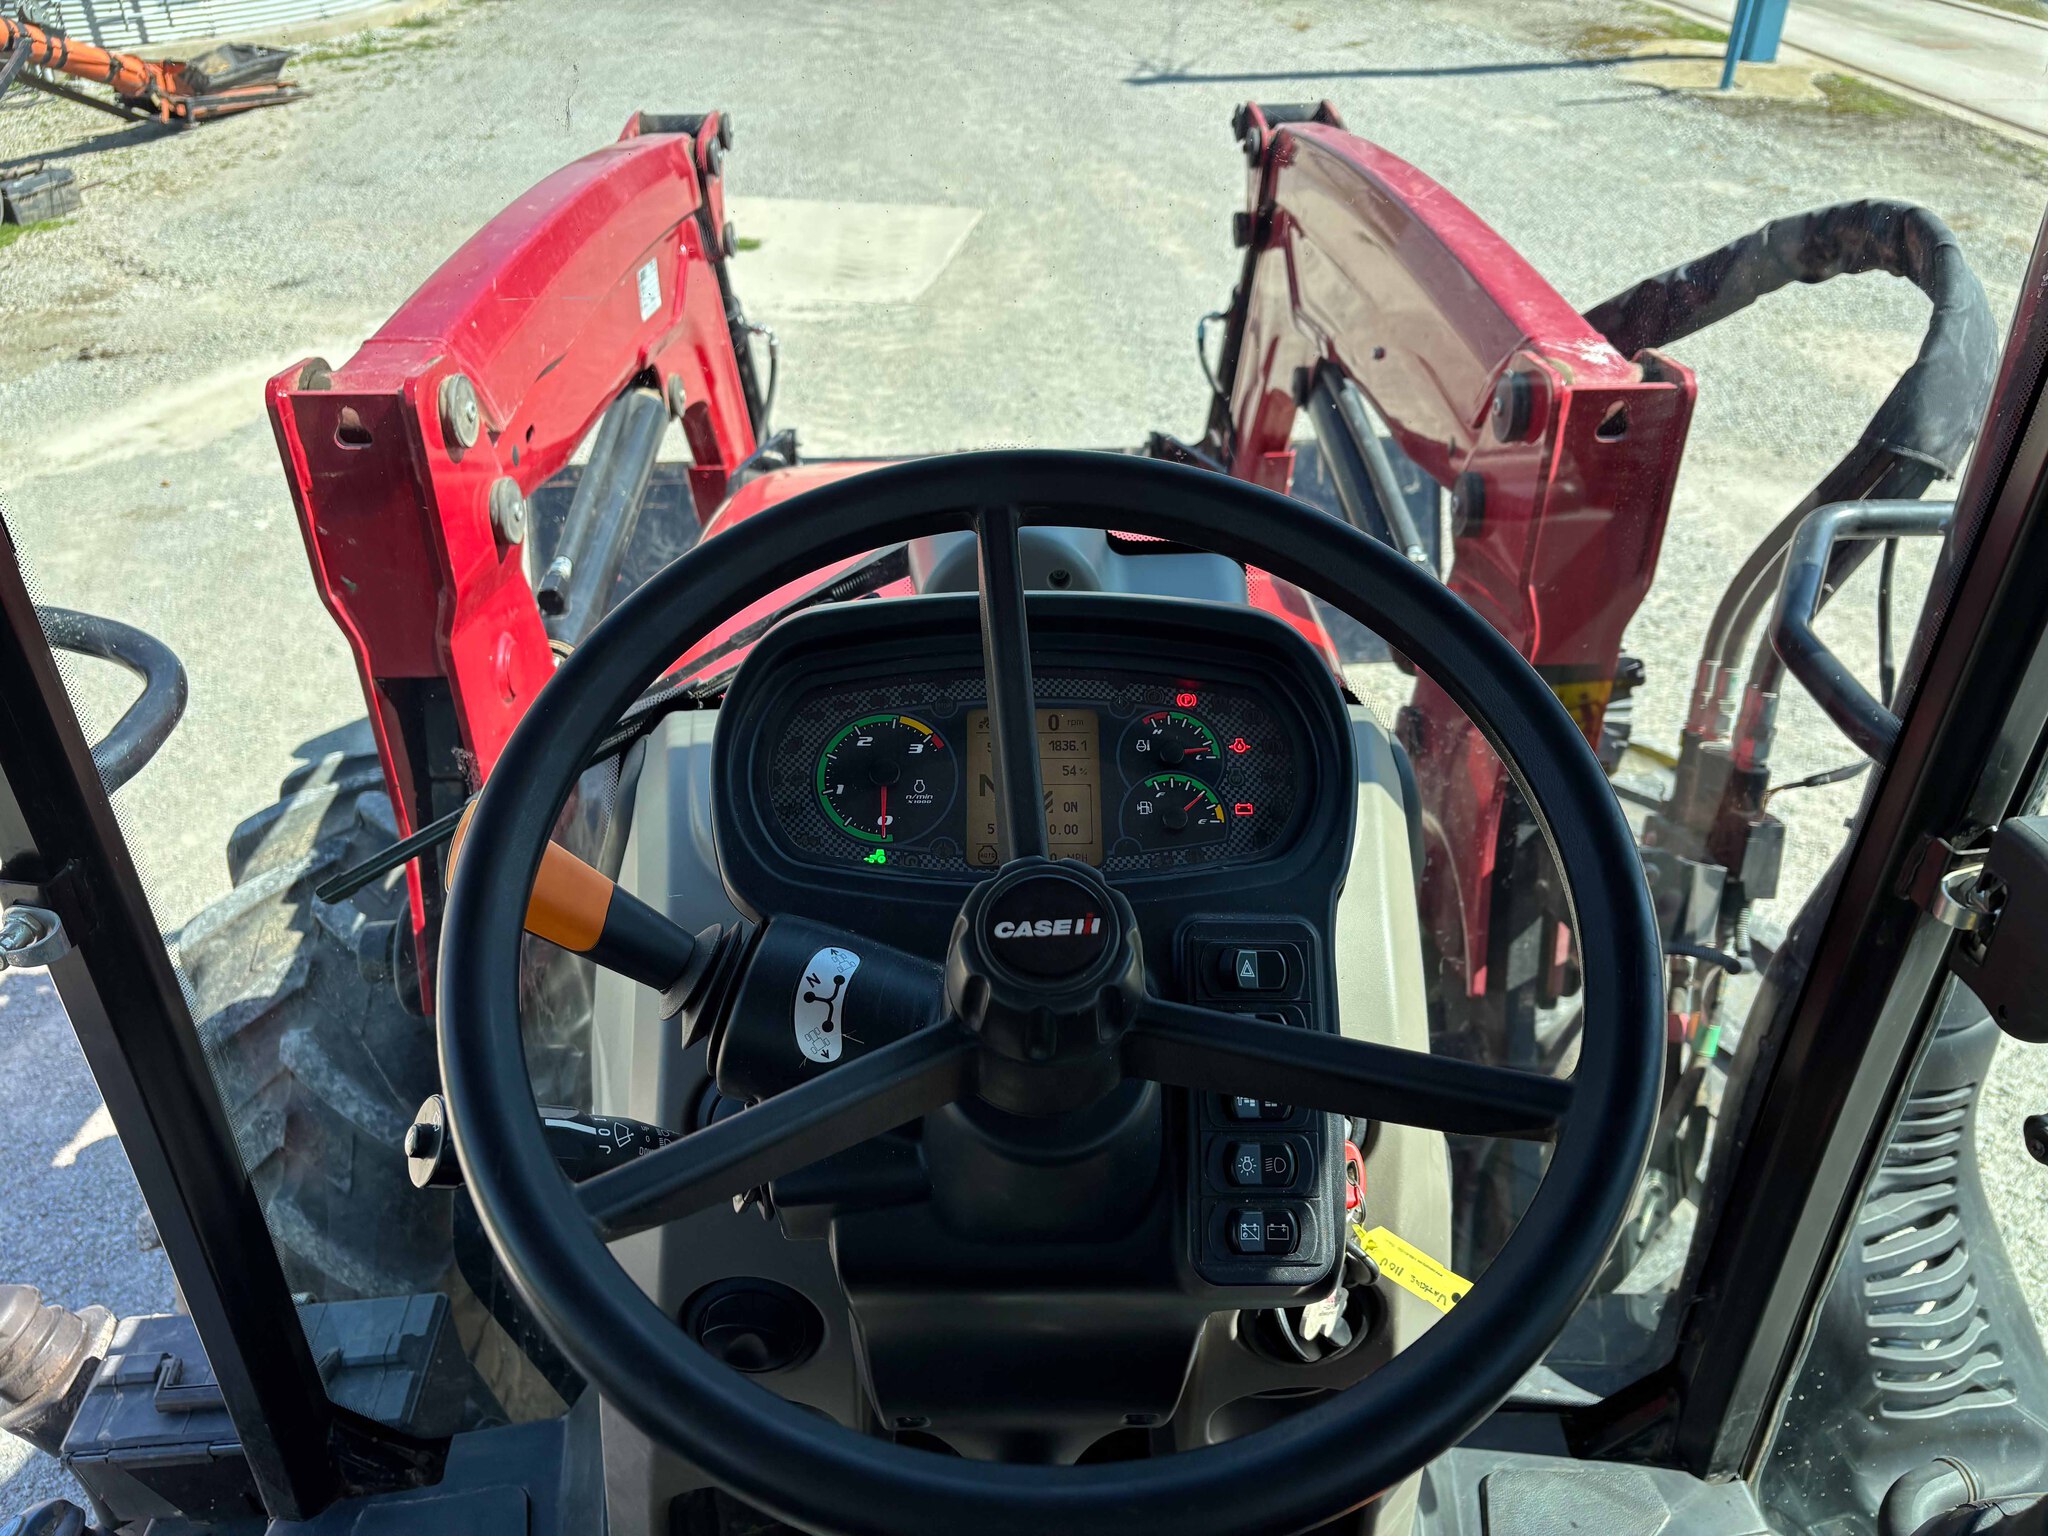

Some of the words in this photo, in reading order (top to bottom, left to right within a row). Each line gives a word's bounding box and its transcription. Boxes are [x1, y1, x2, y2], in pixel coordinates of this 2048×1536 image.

[1048, 714, 1060, 731] 0
[1067, 718, 1084, 726] rpm
[856, 736, 874, 747] 2
[1048, 740, 1088, 752] 1836.1
[908, 743, 925, 754] 3
[836, 784, 845, 795] 1
[1063, 801, 1078, 813] ON
[877, 815, 894, 826] 0
[987, 823, 995, 834] 5
[993, 919, 1072, 939] CASE
[805, 972, 822, 989] N
